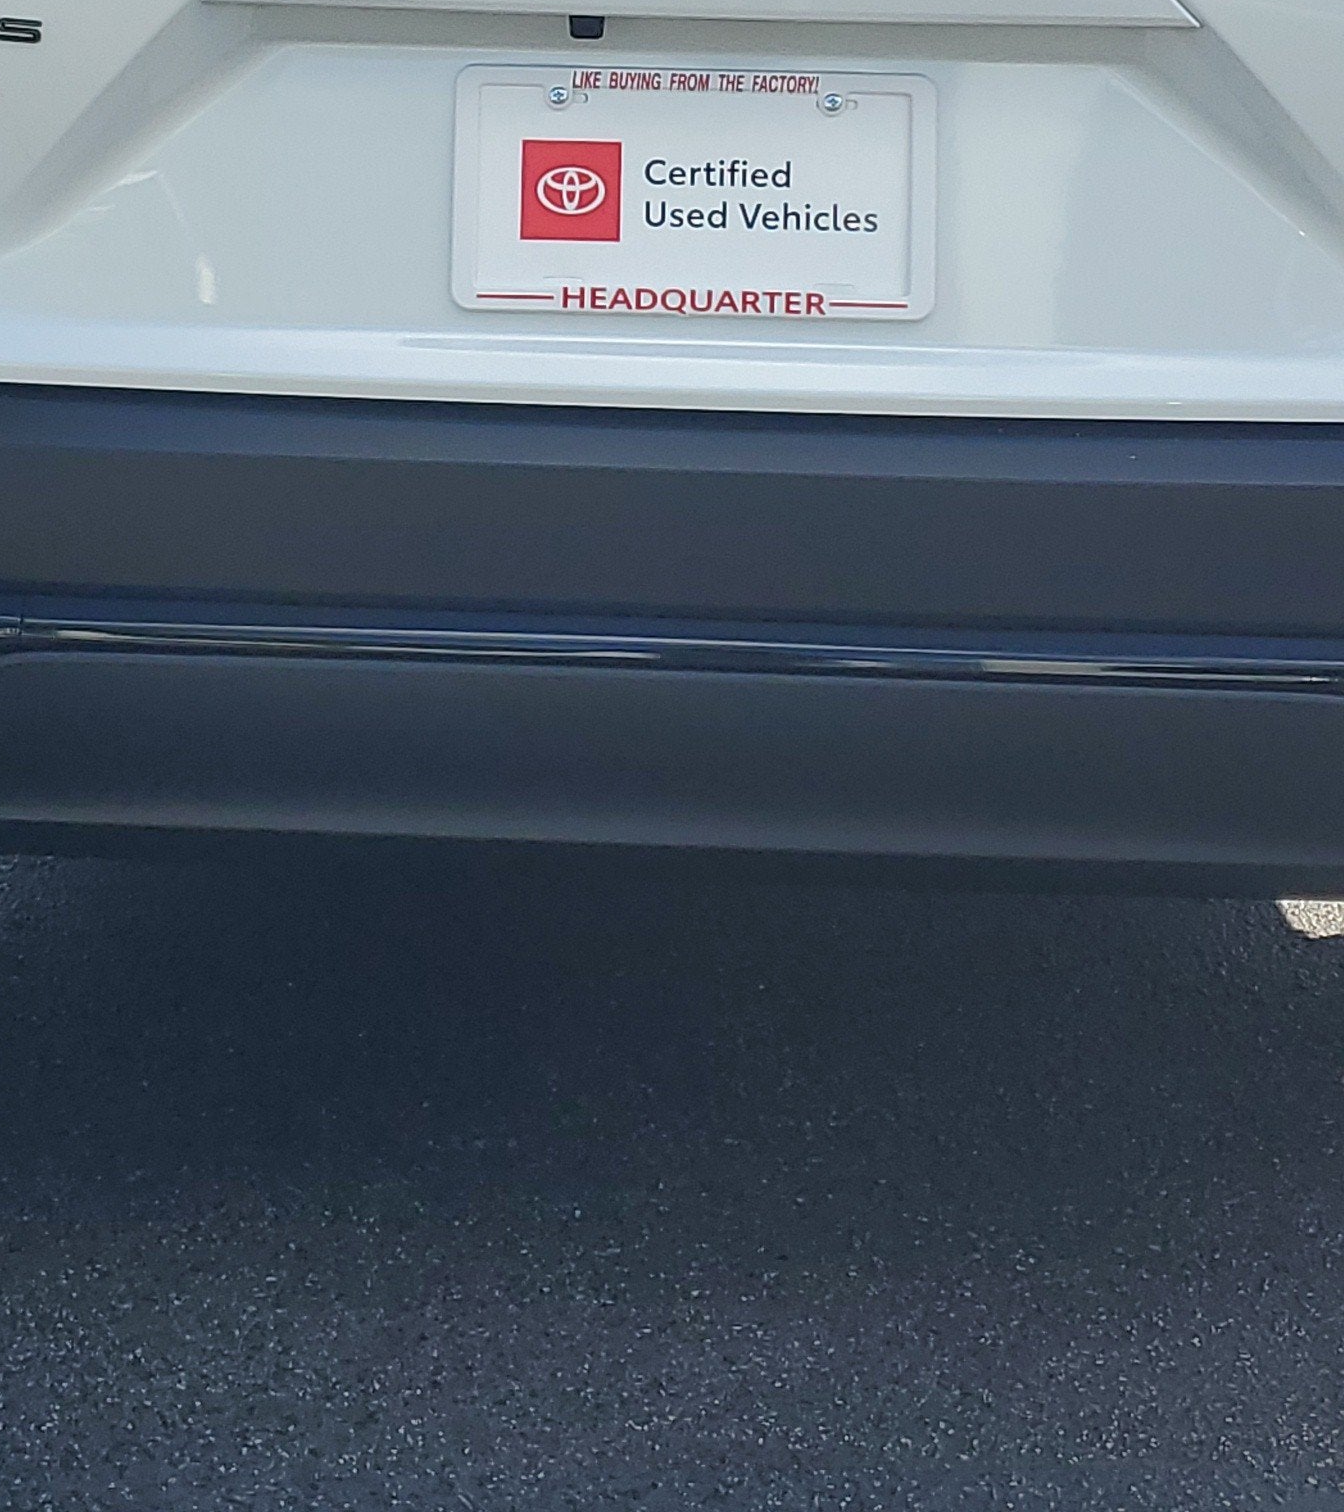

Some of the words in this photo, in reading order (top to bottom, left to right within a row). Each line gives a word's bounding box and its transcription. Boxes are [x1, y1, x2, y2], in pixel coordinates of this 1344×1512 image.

[572, 70, 602, 89] LIKE
[609, 72, 661, 90] BUYING
[668, 73, 711, 92] FROM
[718, 74, 746, 93] THE
[752, 75, 820, 94] FACTORY!
[644, 159, 793, 189] Certified
[644, 201, 728, 230] Used
[739, 203, 879, 233] Vehicles
[560, 286, 827, 316] HEADQUARTER
